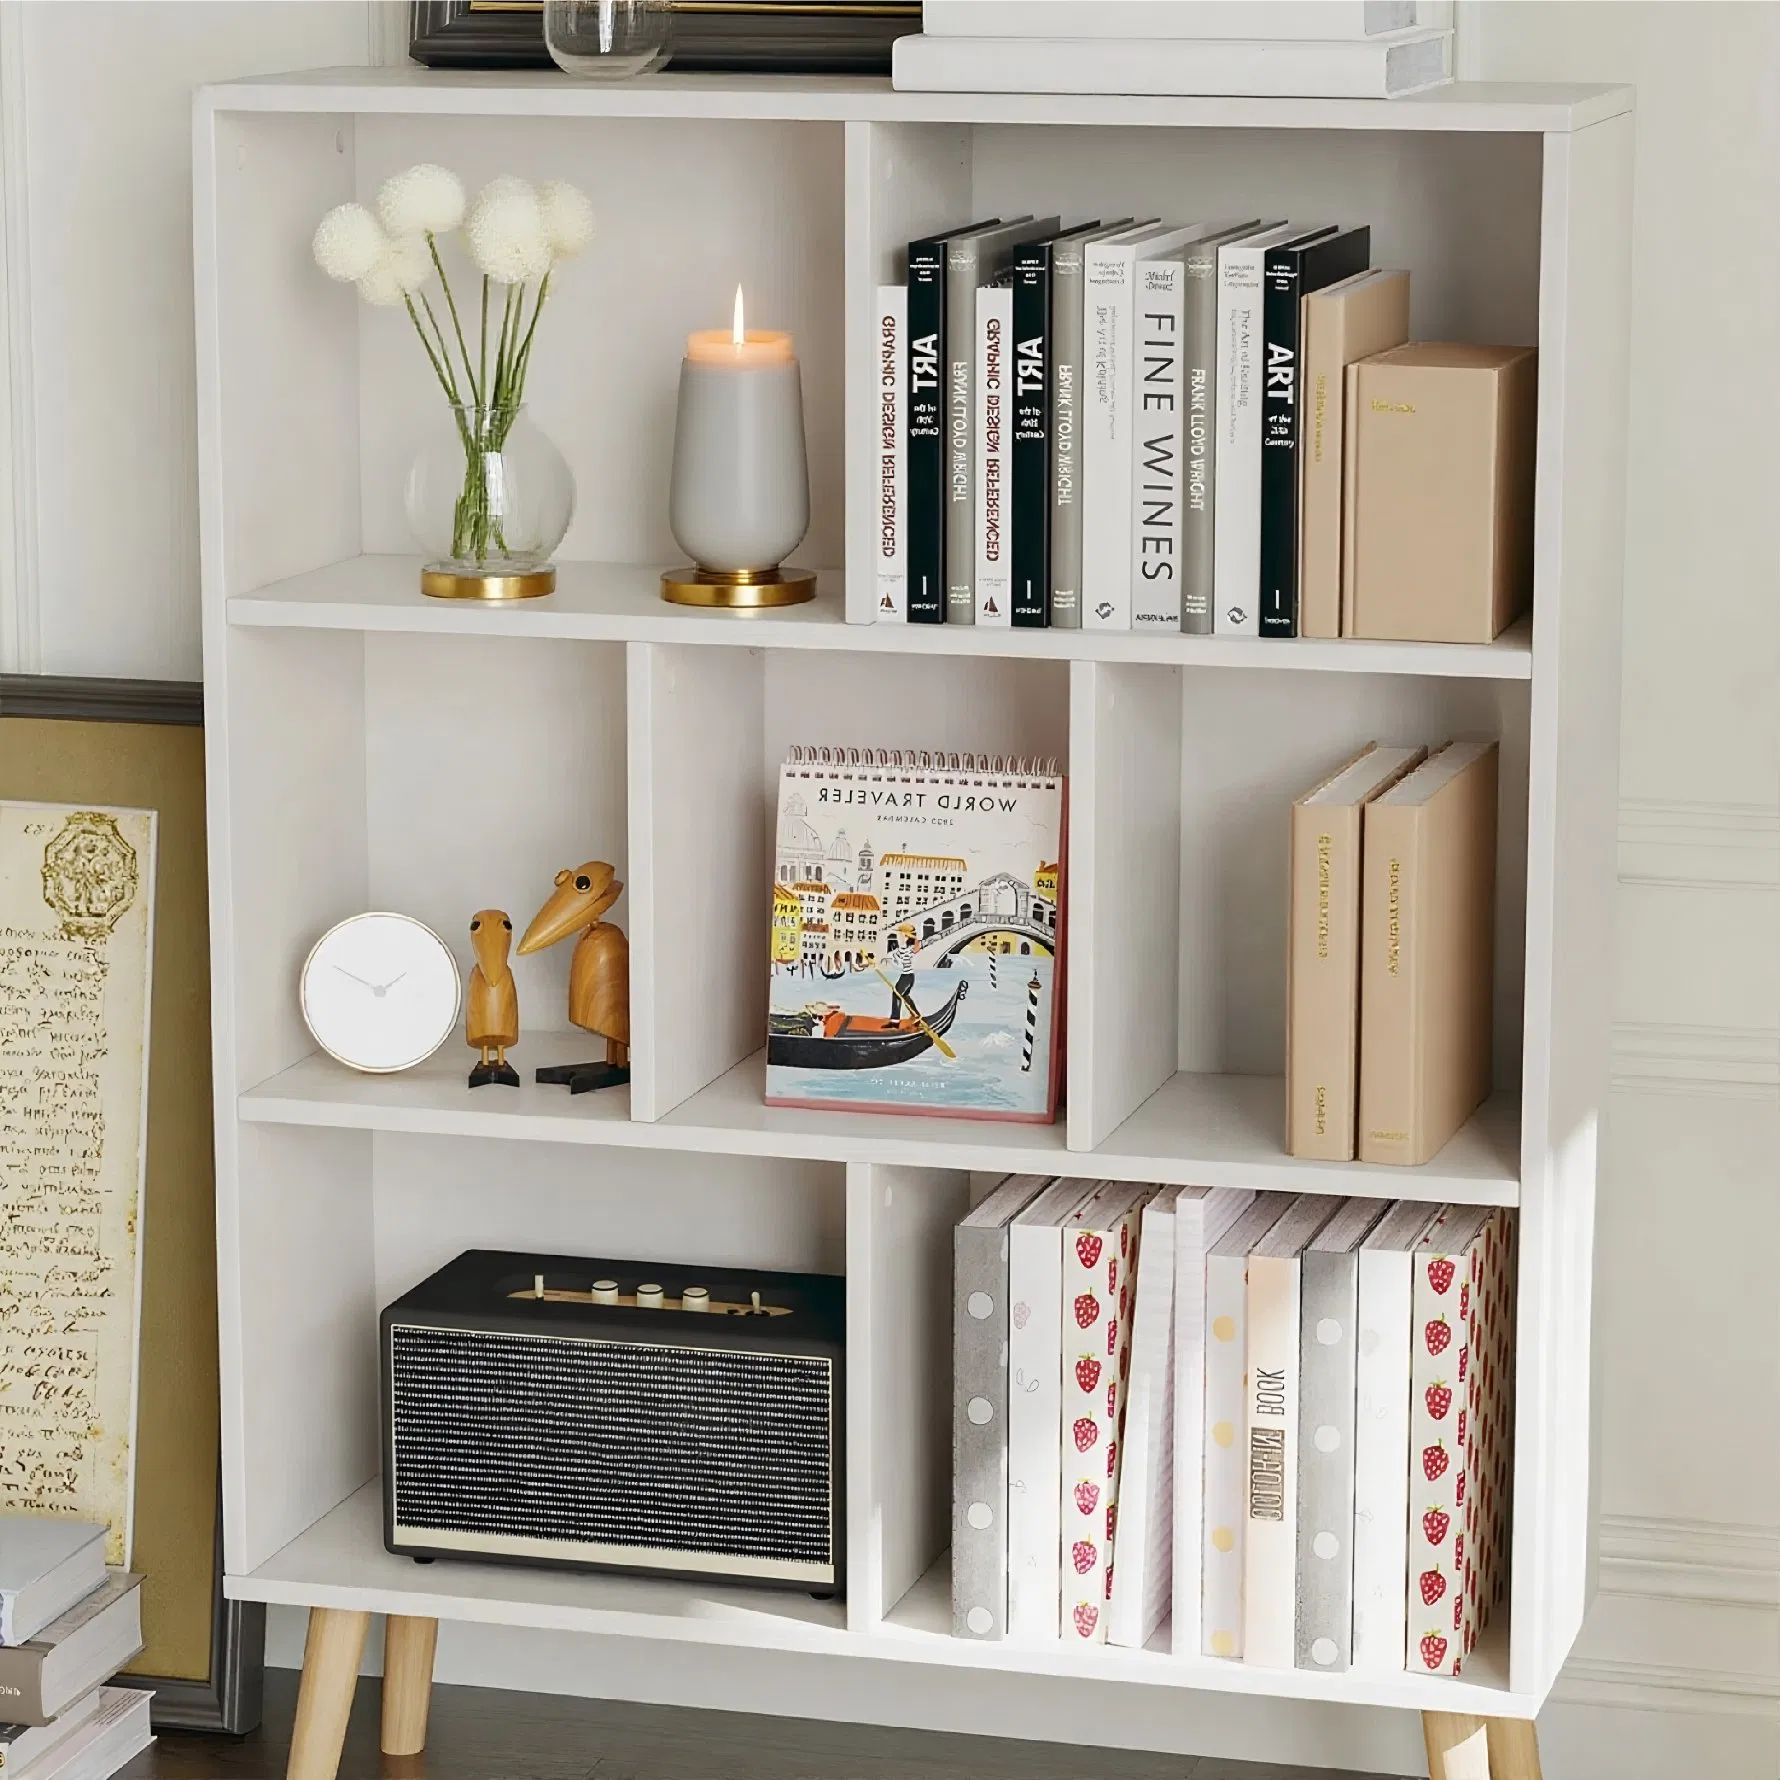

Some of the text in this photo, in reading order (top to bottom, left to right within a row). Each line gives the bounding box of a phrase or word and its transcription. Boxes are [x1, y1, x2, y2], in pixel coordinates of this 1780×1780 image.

[1143, 312, 1175, 413] FINE
[1191, 368, 1206, 411] FRANK
[1267, 341, 1294, 404] ART
[1191, 414, 1206, 456] LLOYD
[1142, 434, 1175, 580] WINES
